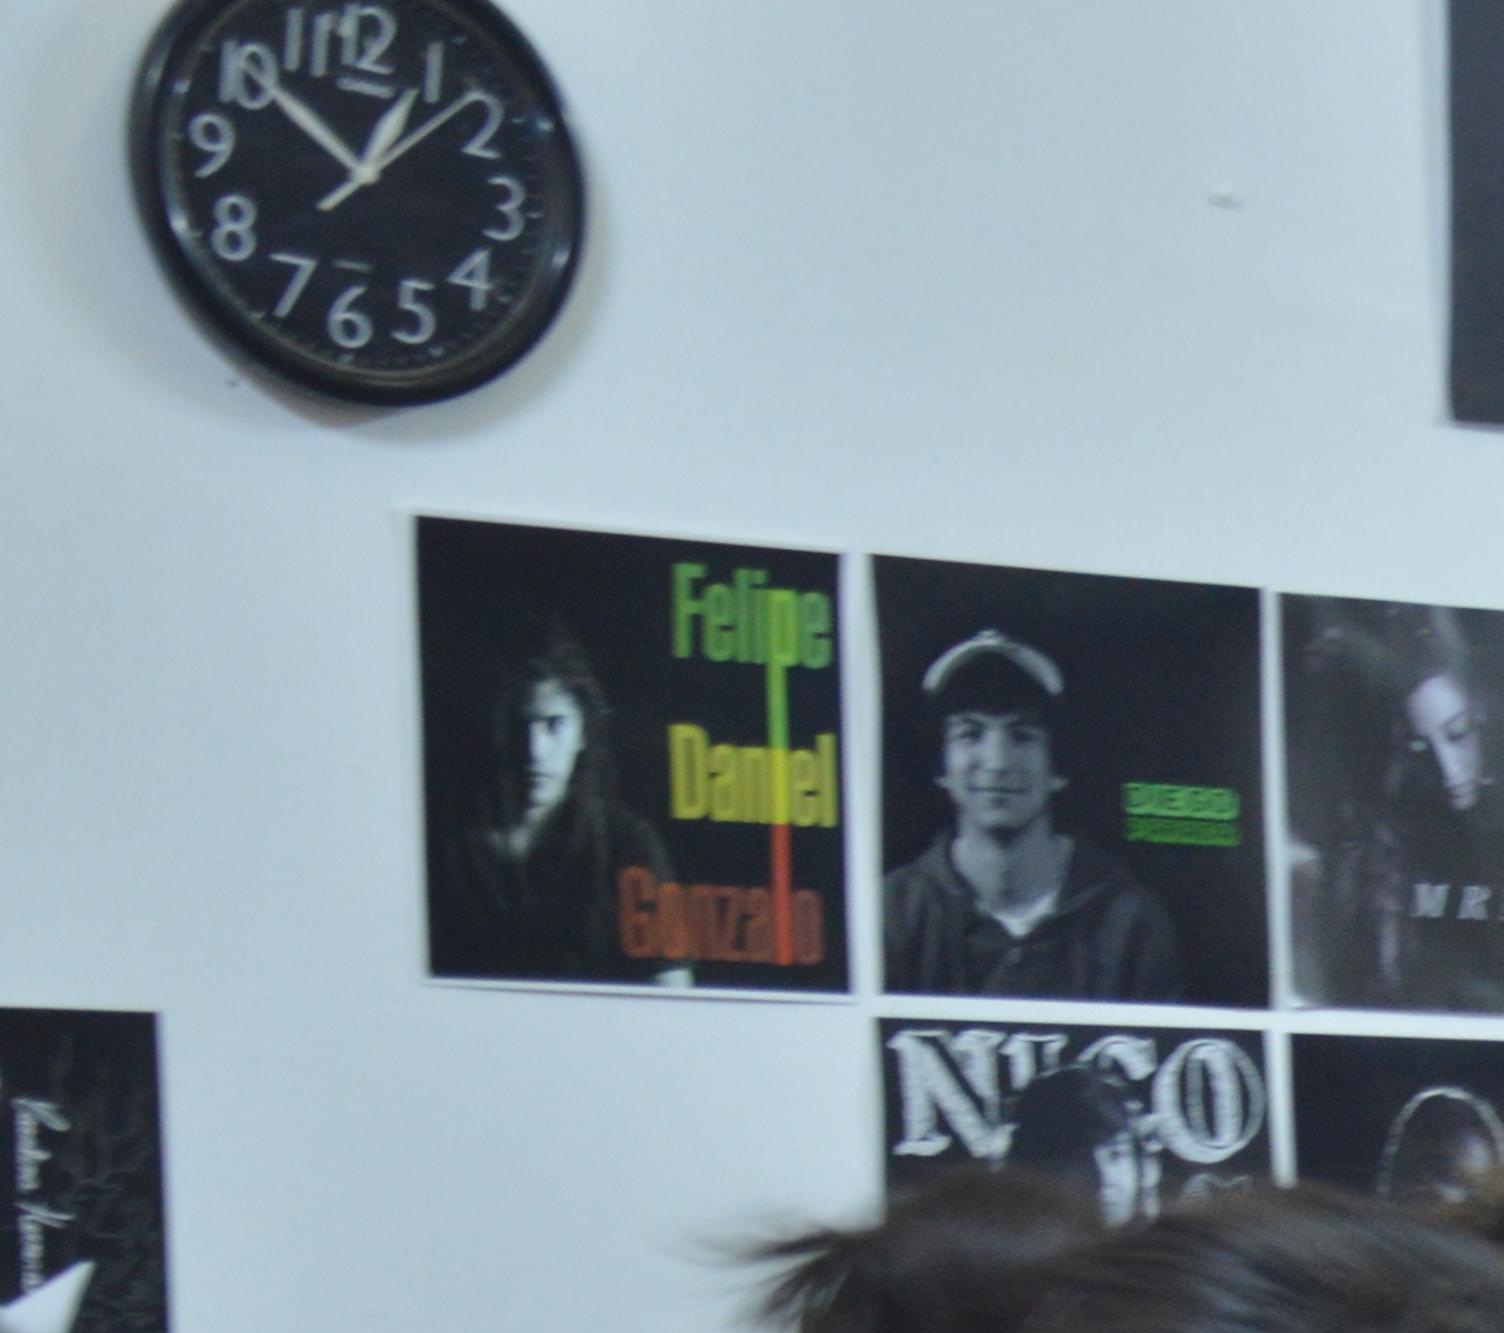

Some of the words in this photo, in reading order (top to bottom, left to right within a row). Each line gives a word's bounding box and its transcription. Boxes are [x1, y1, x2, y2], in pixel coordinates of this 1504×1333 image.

[284, 8, 337, 78] 11
[337, 2, 397, 74] 12
[423, 41, 444, 103] 1
[218, 38, 279, 110] 10
[188, 112, 236, 178] 9
[462, 90, 505, 160] 2
[210, 194, 258, 262] 8
[483, 175, 527, 241] 3
[269, 251, 319, 319] 7
[391, 278, 437, 345] 5
[446, 247, 495, 312] 4
[326, 285, 373, 349] 6
[671, 562, 833, 695] Felipe
[667, 721, 839, 828] Daniel
